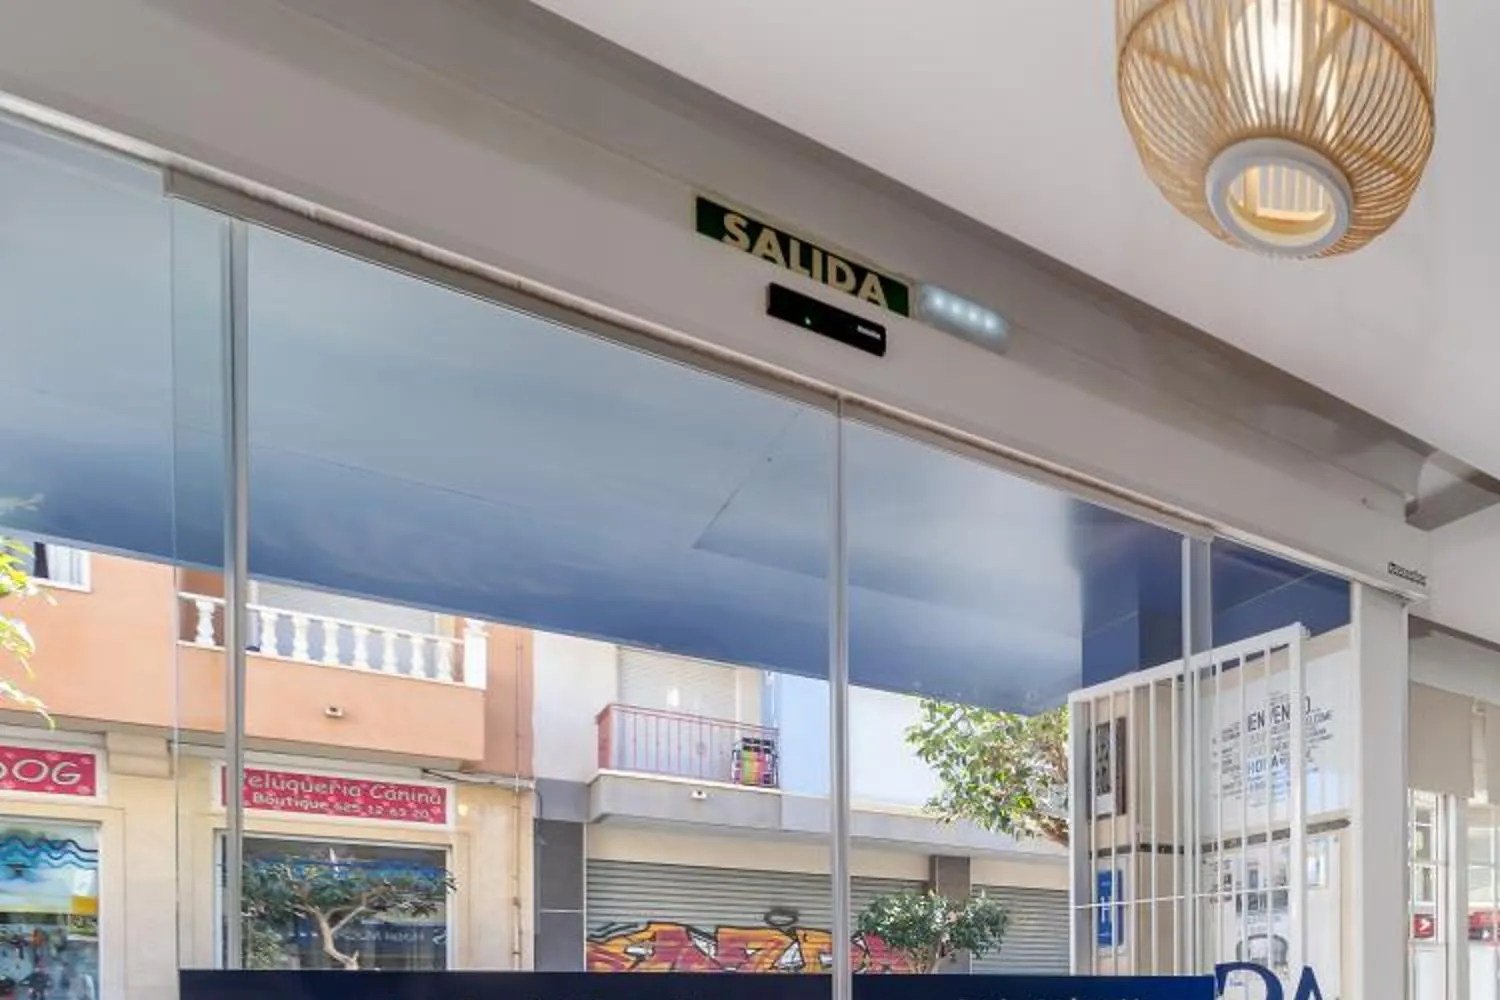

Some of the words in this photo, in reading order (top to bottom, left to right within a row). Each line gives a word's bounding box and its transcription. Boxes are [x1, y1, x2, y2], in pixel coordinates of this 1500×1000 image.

[722, 211, 890, 310] SALIDA
[0, 758, 81, 786] OG
[240, 772, 362, 798] eluqueria
[253, 791, 329, 811] Boutique
